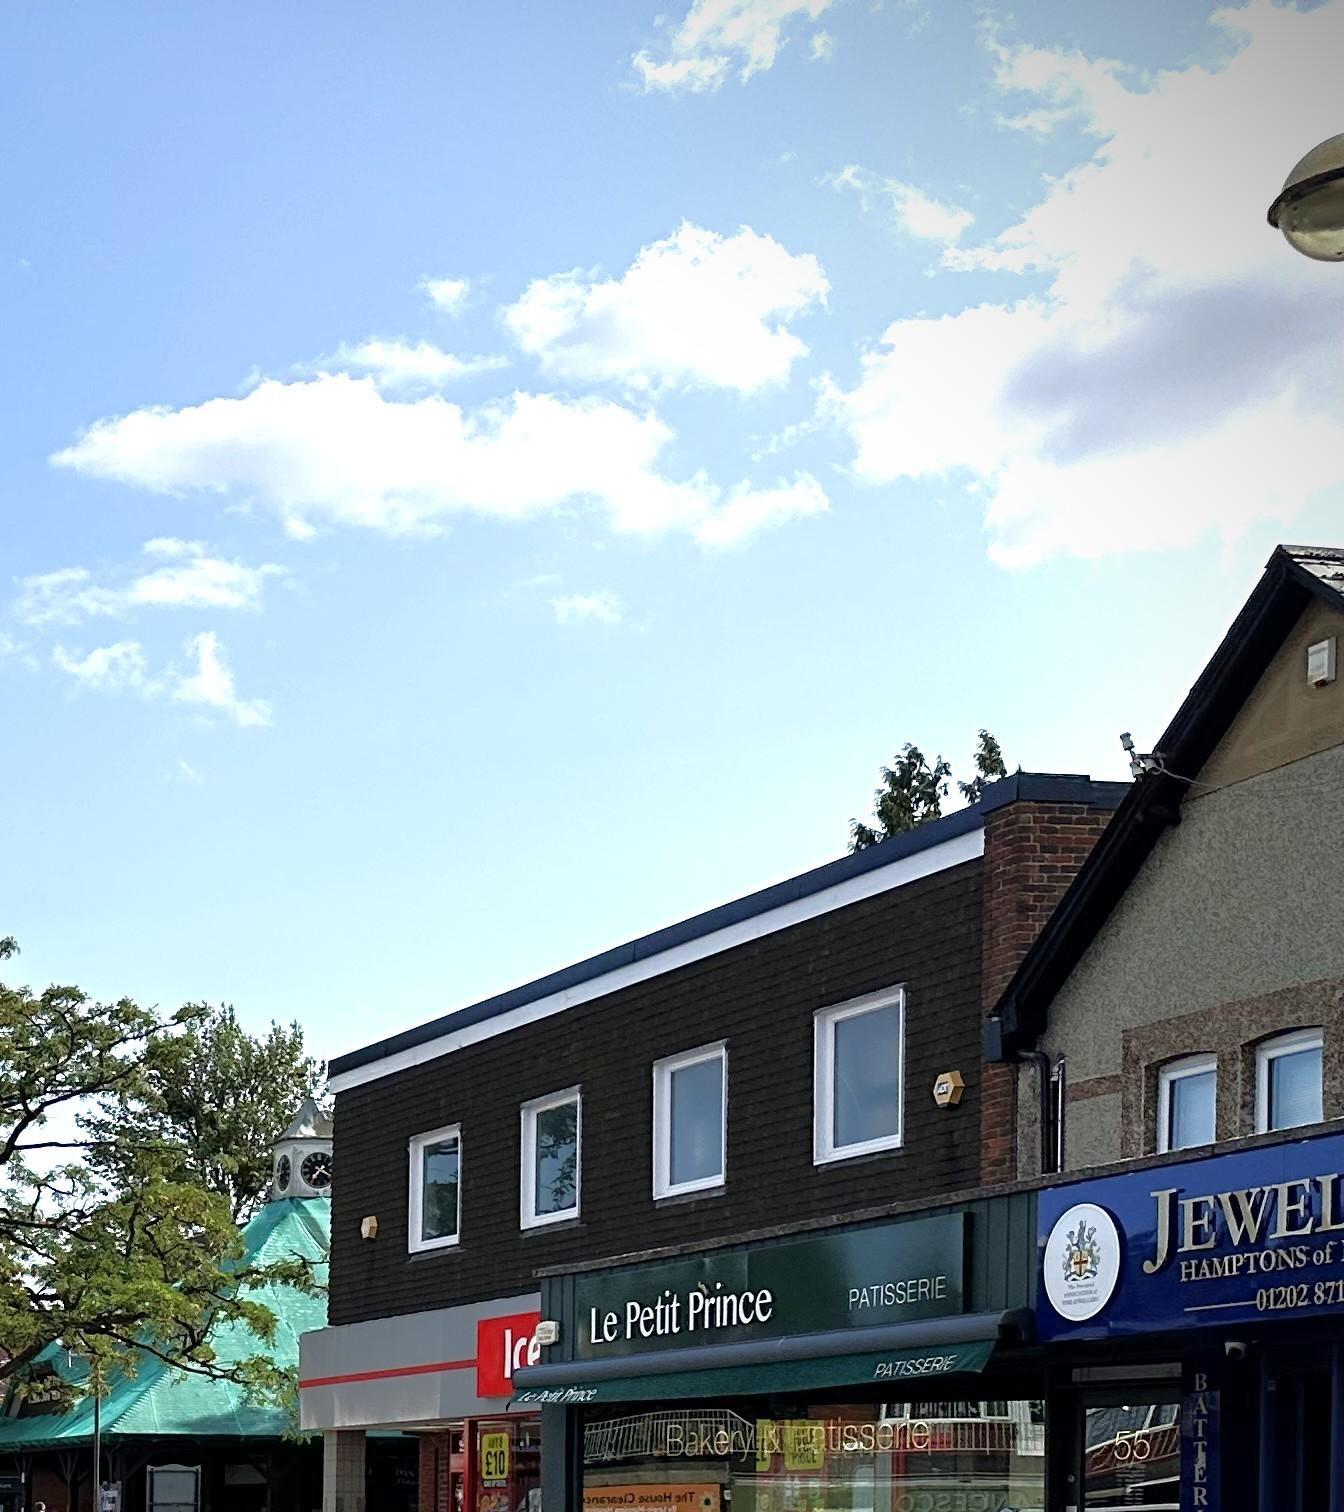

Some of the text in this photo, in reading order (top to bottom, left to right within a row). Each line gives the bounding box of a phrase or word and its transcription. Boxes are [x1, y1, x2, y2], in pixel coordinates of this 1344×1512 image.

[1180, 1246, 1308, 1282] HAMPTONS
[1313, 1241, 1335, 1266] of
[849, 1276, 947, 1311] PATISSERIE
[1256, 1280, 1344, 1311] 01202 871
[590, 1282, 773, 1344] Le Petit Prince
[874, 1354, 958, 1378] PATISSERIE
[517, 1385, 598, 1402] Le Petit Prince
[667, 1424, 754, 1462] Bakery
[1114, 1430, 1150, 1460] 55
[486, 1450, 505, 1475] £10
